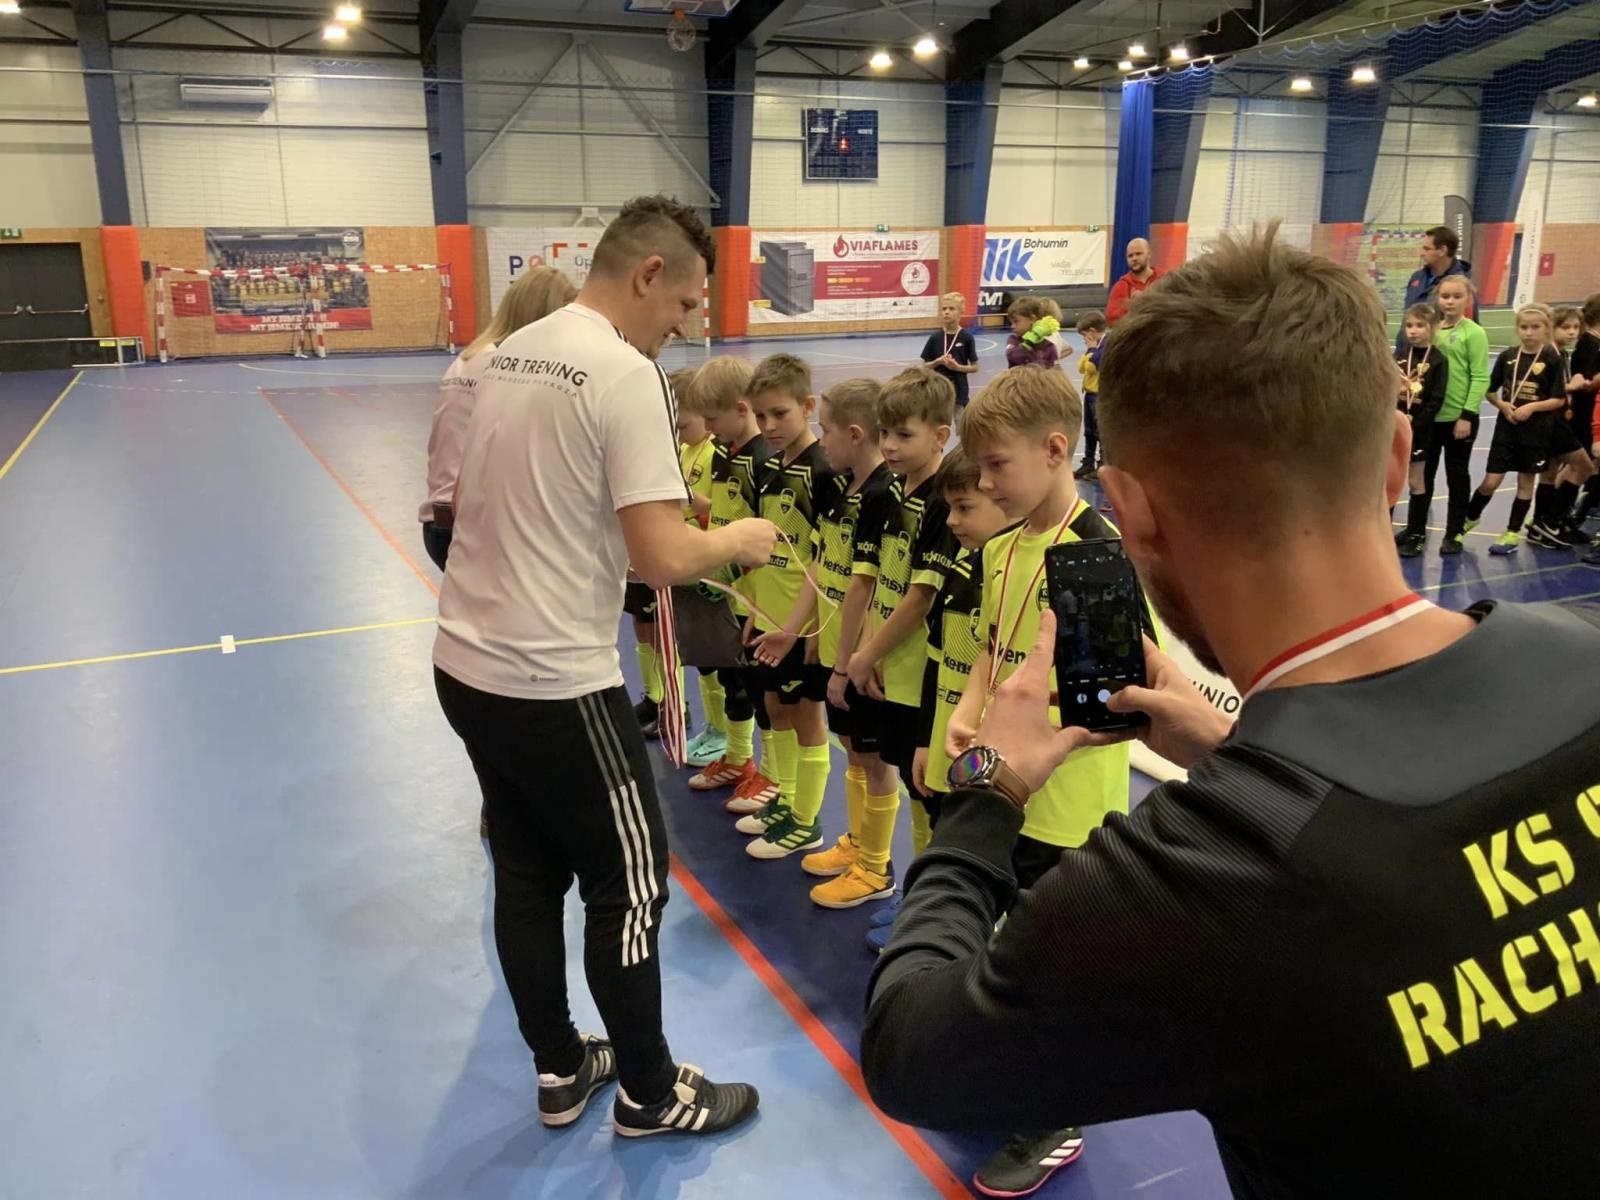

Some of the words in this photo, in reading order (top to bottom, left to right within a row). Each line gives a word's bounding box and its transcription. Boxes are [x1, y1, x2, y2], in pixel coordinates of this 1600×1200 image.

[850, 239, 918, 251] VIAFLAMES
[485, 355, 519, 372] NIOR
[520, 359, 588, 387] TRENING
[1188, 679, 1240, 714] NIO
[1462, 813, 1575, 920] KS
[1386, 902, 1600, 1069] RACH
